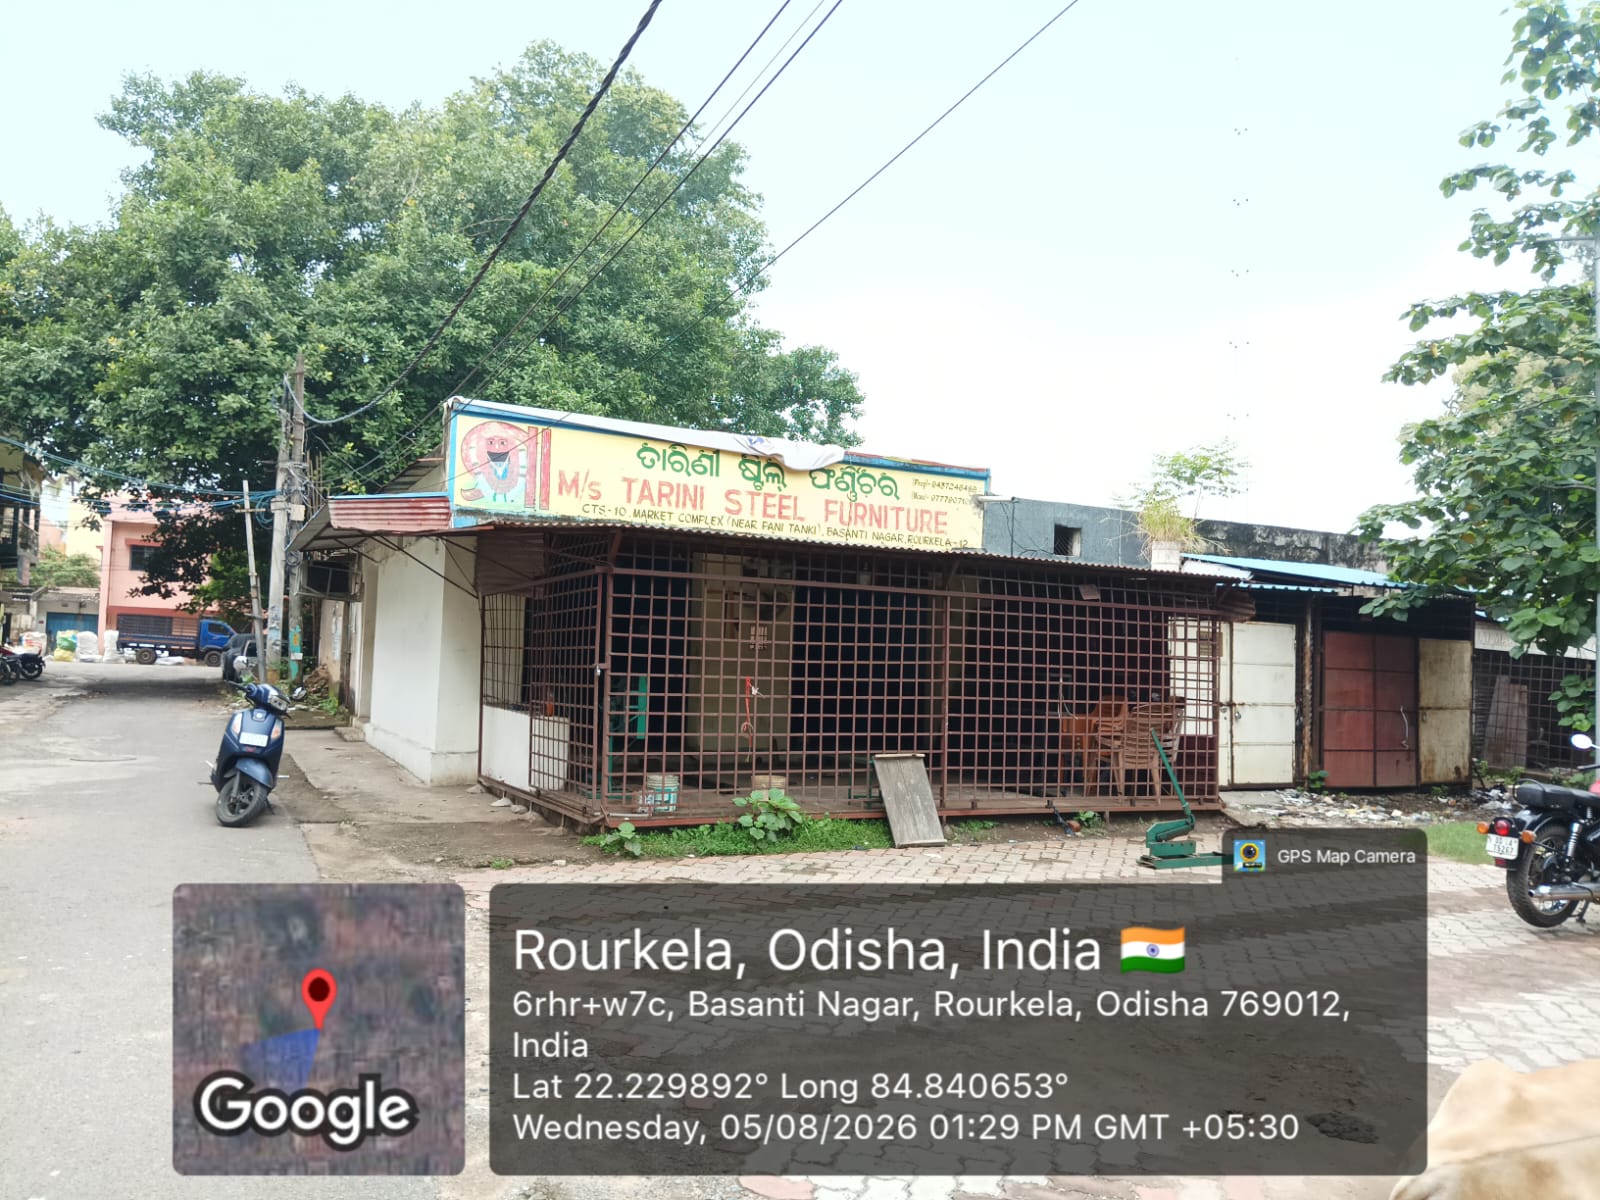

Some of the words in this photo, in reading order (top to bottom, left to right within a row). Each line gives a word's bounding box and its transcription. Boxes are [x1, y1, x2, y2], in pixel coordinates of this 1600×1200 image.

[621, 476, 705, 511] TARINI
[724, 489, 806, 522] STEEL
[824, 498, 948, 535] FURNITURE
[632, 508, 674, 522] MARKET
[678, 513, 724, 527] COMPLEX
[827, 526, 868, 541] BASANTI
